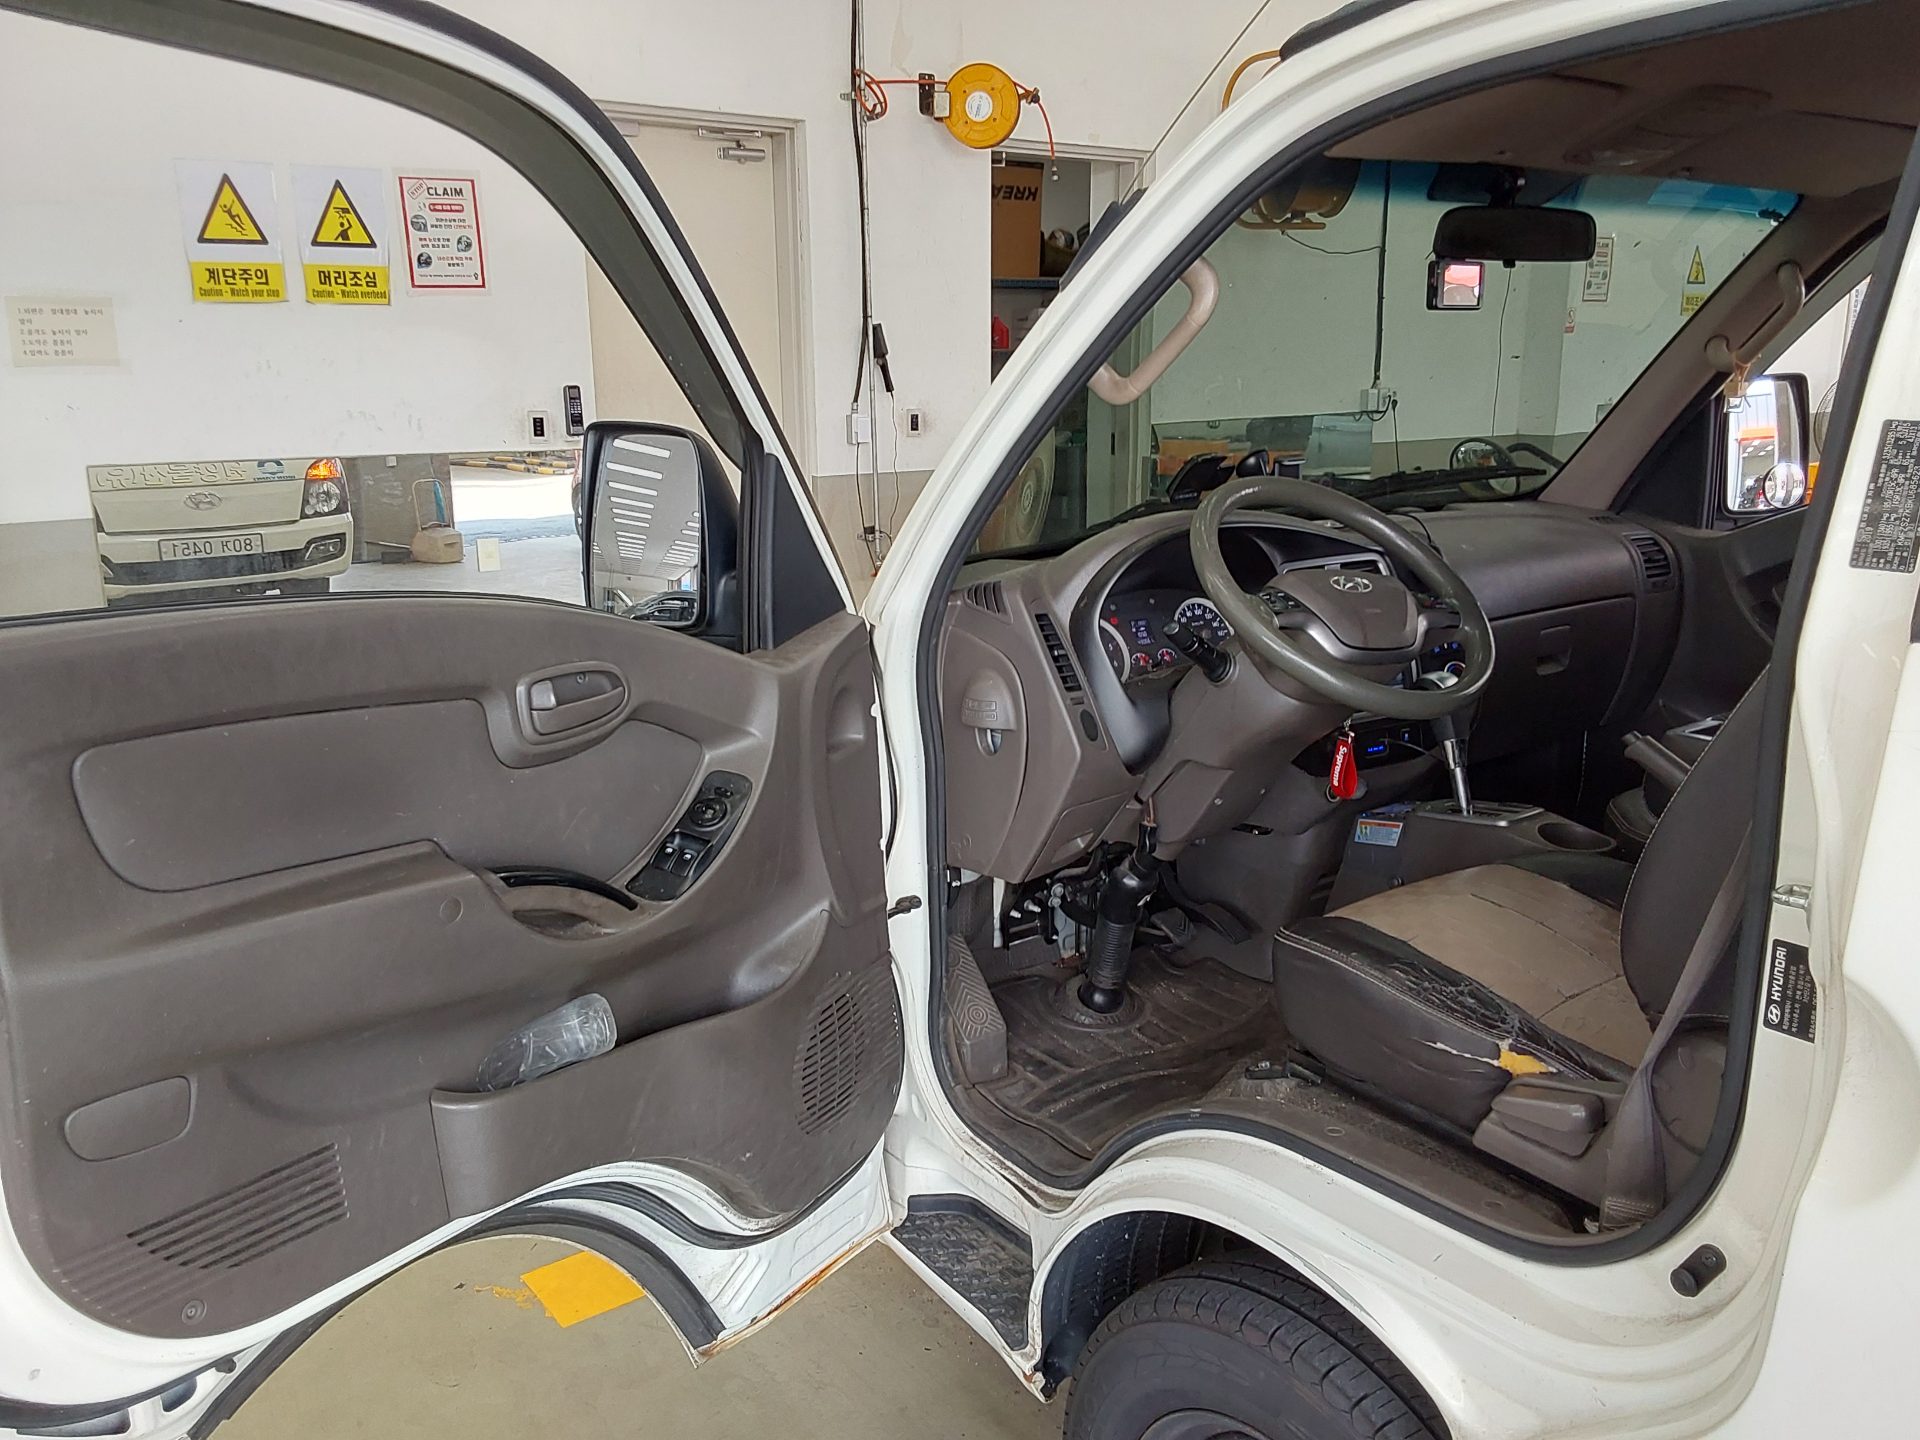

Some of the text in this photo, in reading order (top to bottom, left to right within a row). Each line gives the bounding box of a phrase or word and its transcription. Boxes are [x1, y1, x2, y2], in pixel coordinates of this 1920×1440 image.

[427, 187, 464, 197] CLAIM
[204, 267, 270, 286] 계단주의
[318, 270, 378, 288] 머리조심
[199, 286, 224, 297] Caution
[230, 287, 250, 298] Watch
[251, 289, 265, 299] your
[266, 288, 280, 299] step
[312, 288, 335, 299] Caution
[340, 288, 360, 299] Watch
[360, 289, 387, 300] overhead
[1333, 745, 1348, 787] Supreme
[1770, 946, 1788, 1001] HYUNDAI
